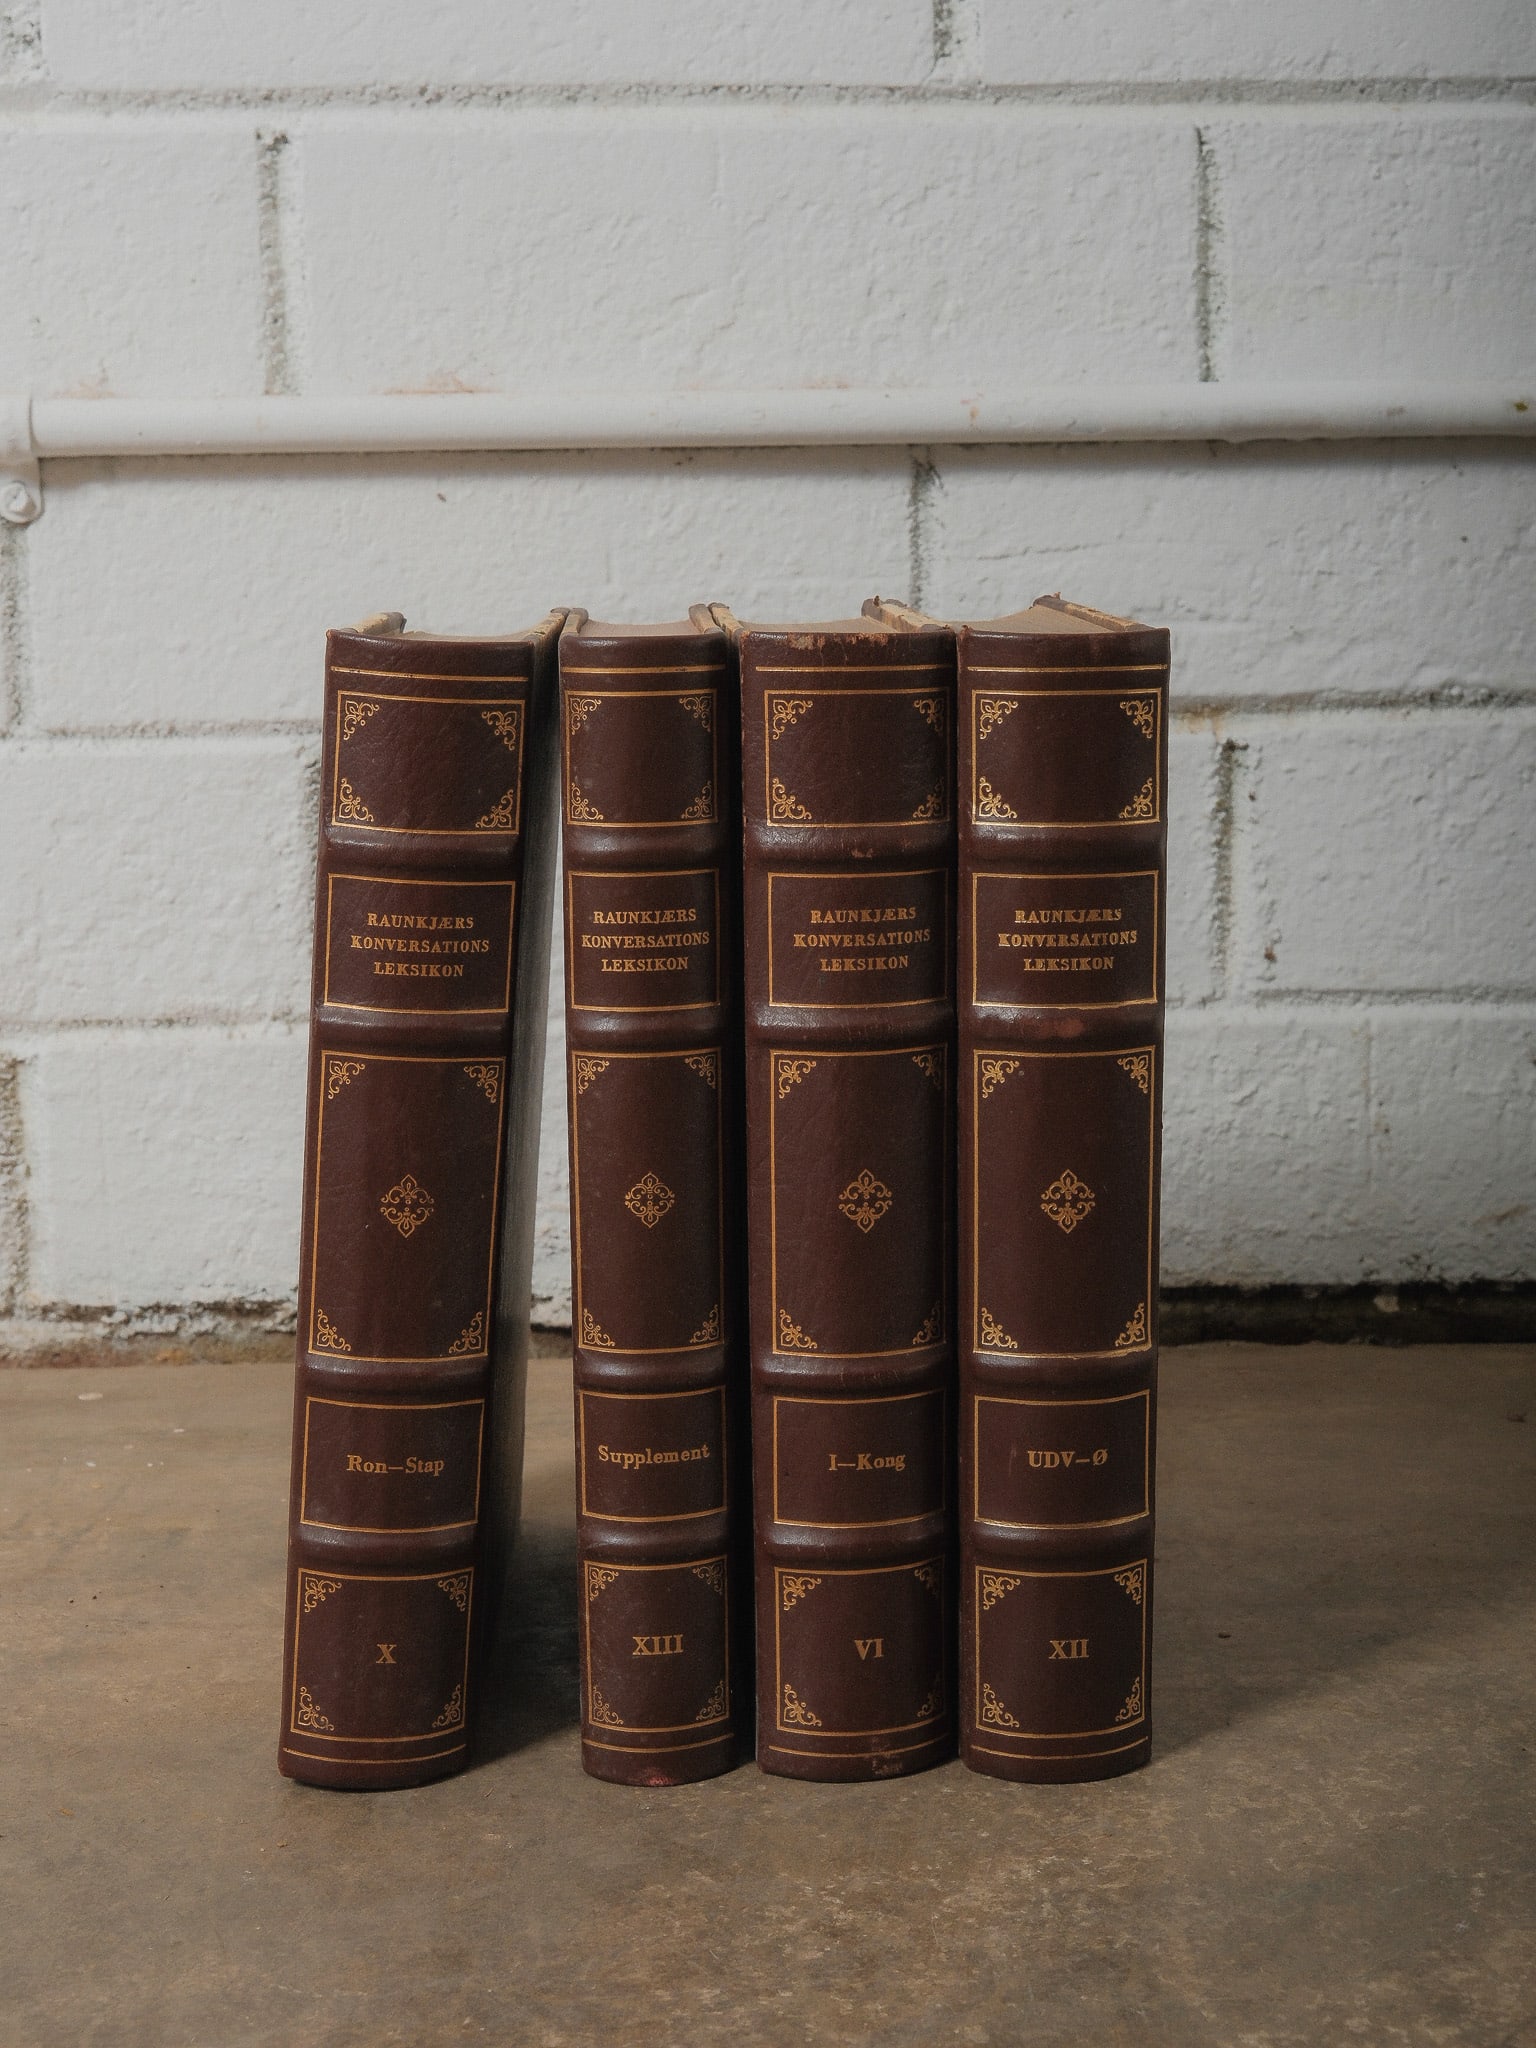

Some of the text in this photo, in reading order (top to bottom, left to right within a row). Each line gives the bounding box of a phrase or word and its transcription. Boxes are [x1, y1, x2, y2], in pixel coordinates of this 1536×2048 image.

[368, 912, 474, 930] RAUNKJÆRS
[593, 909, 697, 925] RAUNKJÆRS
[811, 907, 916, 924] RAUNKJÆRS
[1015, 908, 1121, 924] RAUNKJÆRS
[350, 935, 489, 953] KONVERSATIONS
[581, 932, 710, 949] KONVERSATIONS
[794, 929, 931, 948] KONVERSATIONS
[999, 930, 1137, 947] KONVERSATIONS
[373, 961, 464, 977] LEKSIKON
[601, 956, 688, 973] LEKSIKON
[820, 955, 908, 971] LEKSIKON
[1024, 956, 1114, 971] LEKSIKON
[598, 1444, 709, 1469] Supplement
[632, 1634, 683, 1656] XIII
[854, 1638, 884, 1660] VI
[1049, 1639, 1089, 1660] XII
[377, 1644, 397, 1664] X
